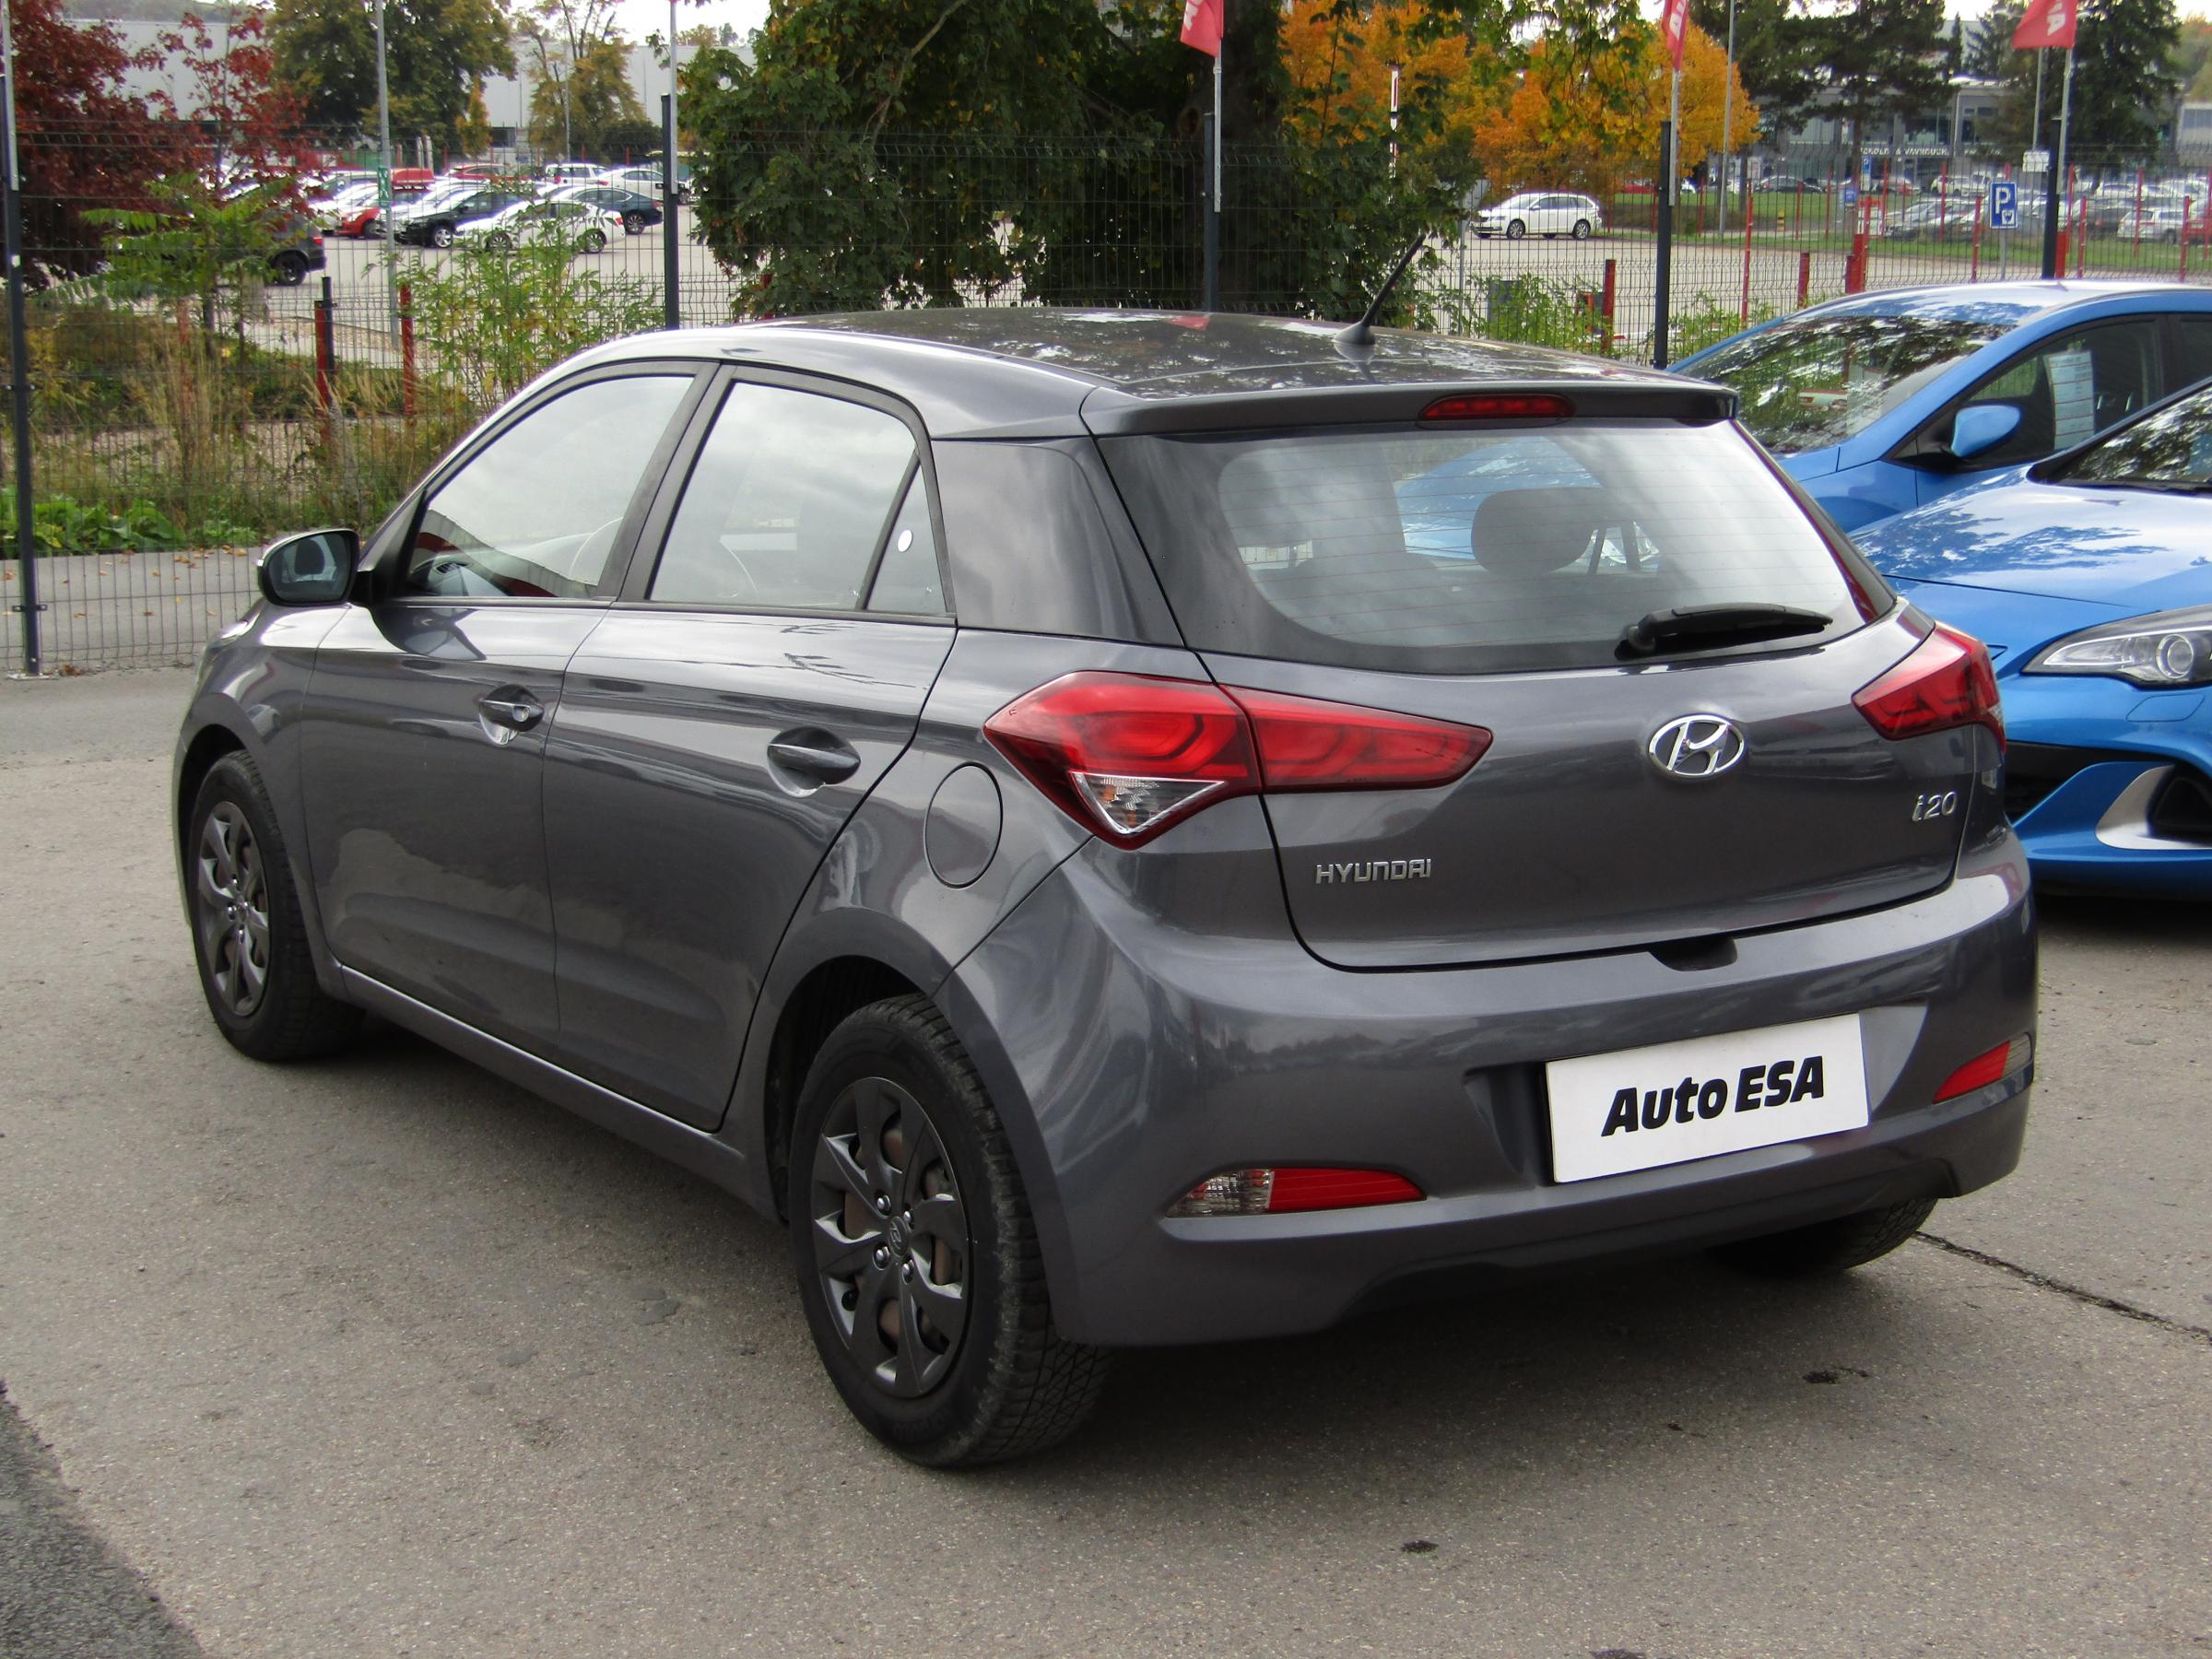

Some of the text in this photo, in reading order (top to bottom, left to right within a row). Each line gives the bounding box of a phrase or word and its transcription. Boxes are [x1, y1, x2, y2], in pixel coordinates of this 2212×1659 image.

[1995, 187, 2010, 214] P
[1912, 791, 1958, 822] i20
[1315, 858, 1431, 884] HYUNDAI
[1601, 1055, 1825, 1137] Auto ESA
